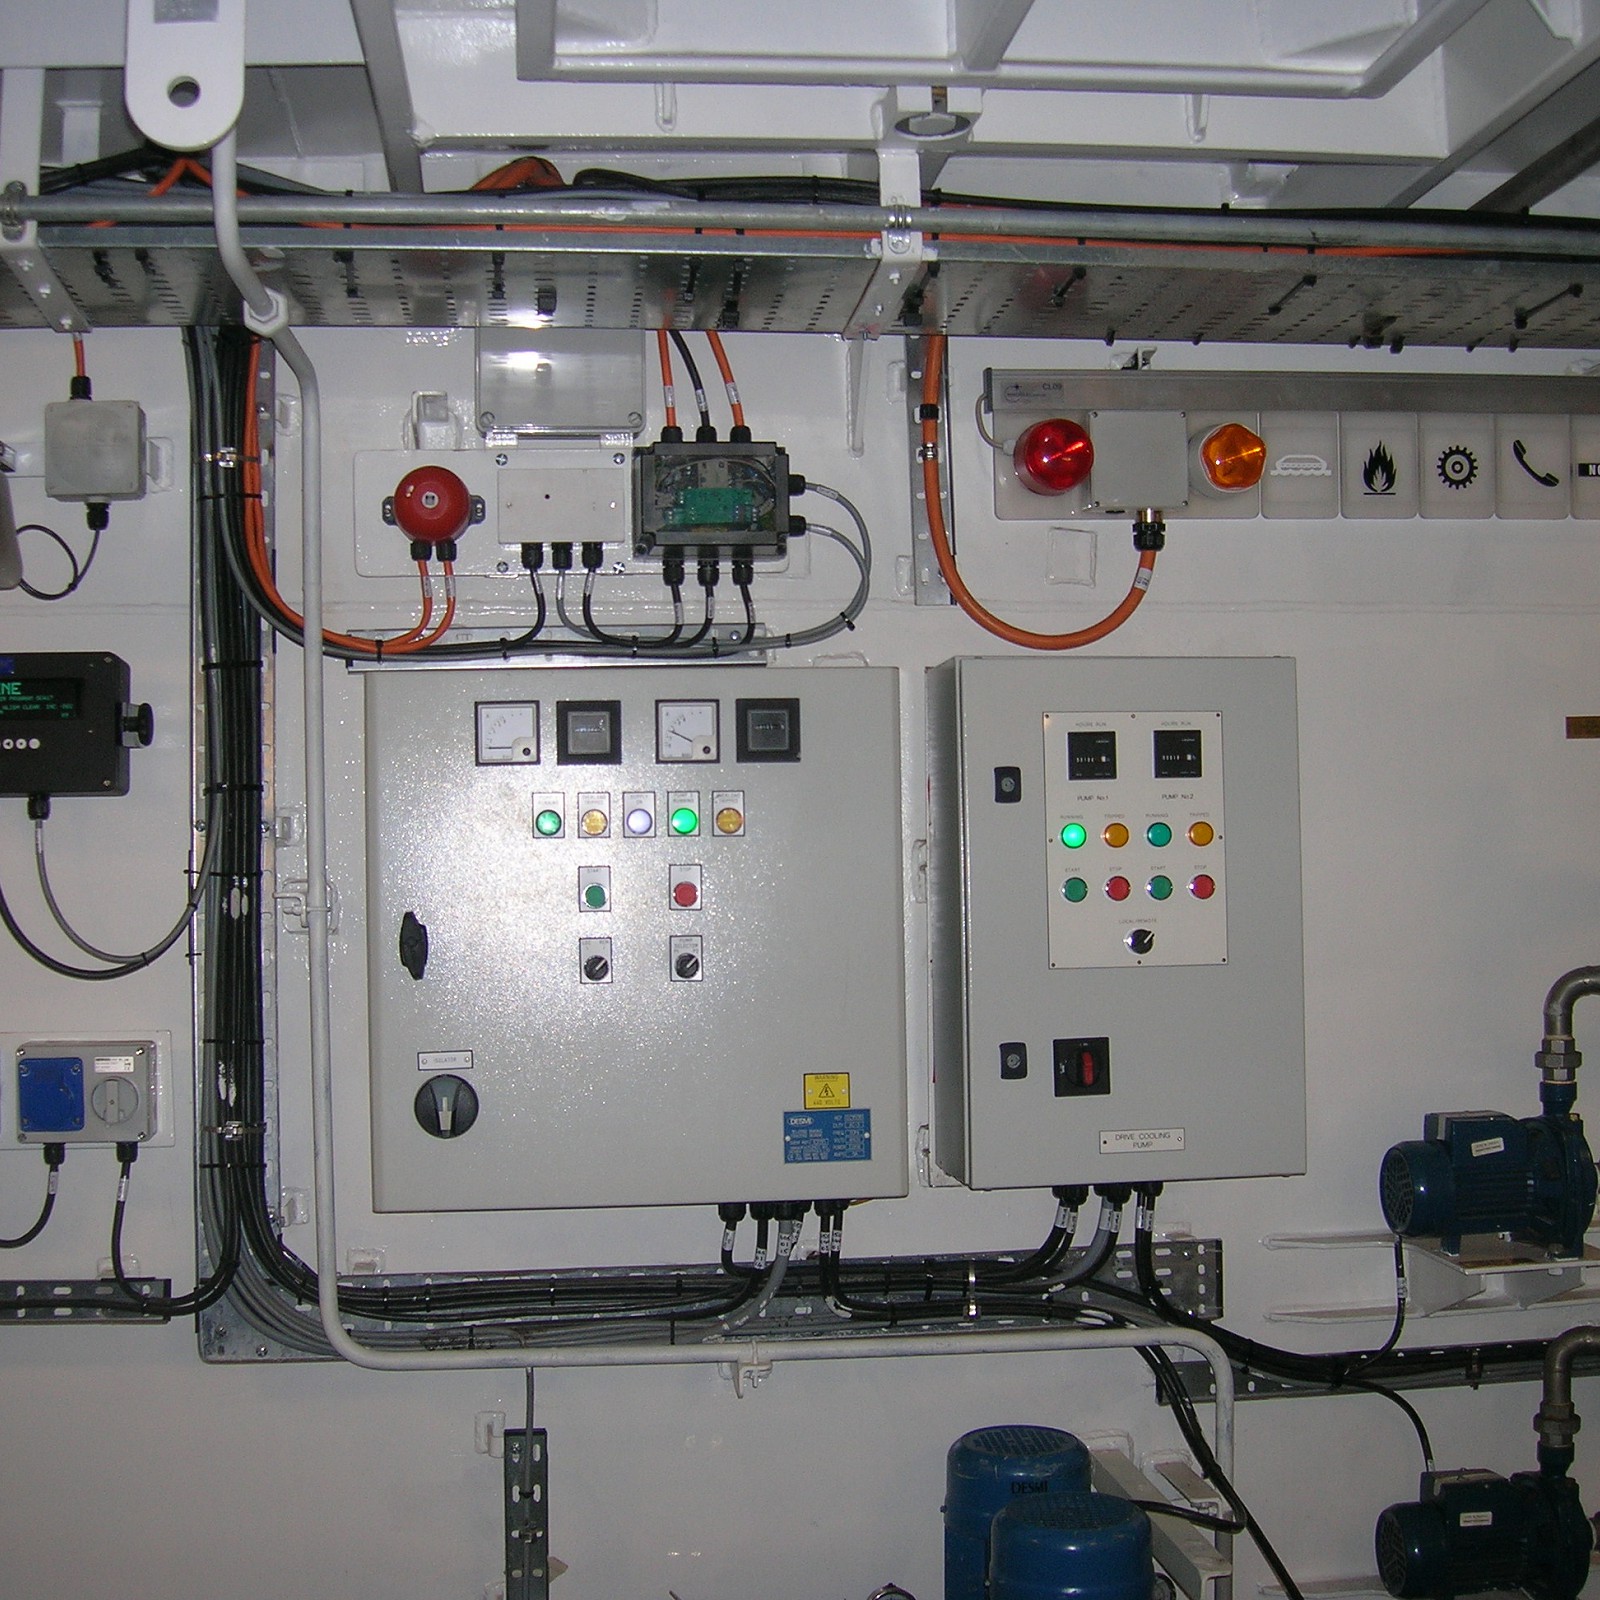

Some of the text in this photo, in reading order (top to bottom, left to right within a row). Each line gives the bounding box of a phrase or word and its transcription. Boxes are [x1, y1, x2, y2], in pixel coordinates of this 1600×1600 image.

[0, 682, 22, 695] NE
[1139, 1132, 1171, 1140] COOLING
[1132, 1141, 1153, 1149] PUMP
[1011, 1481, 1048, 1494] DESMI
